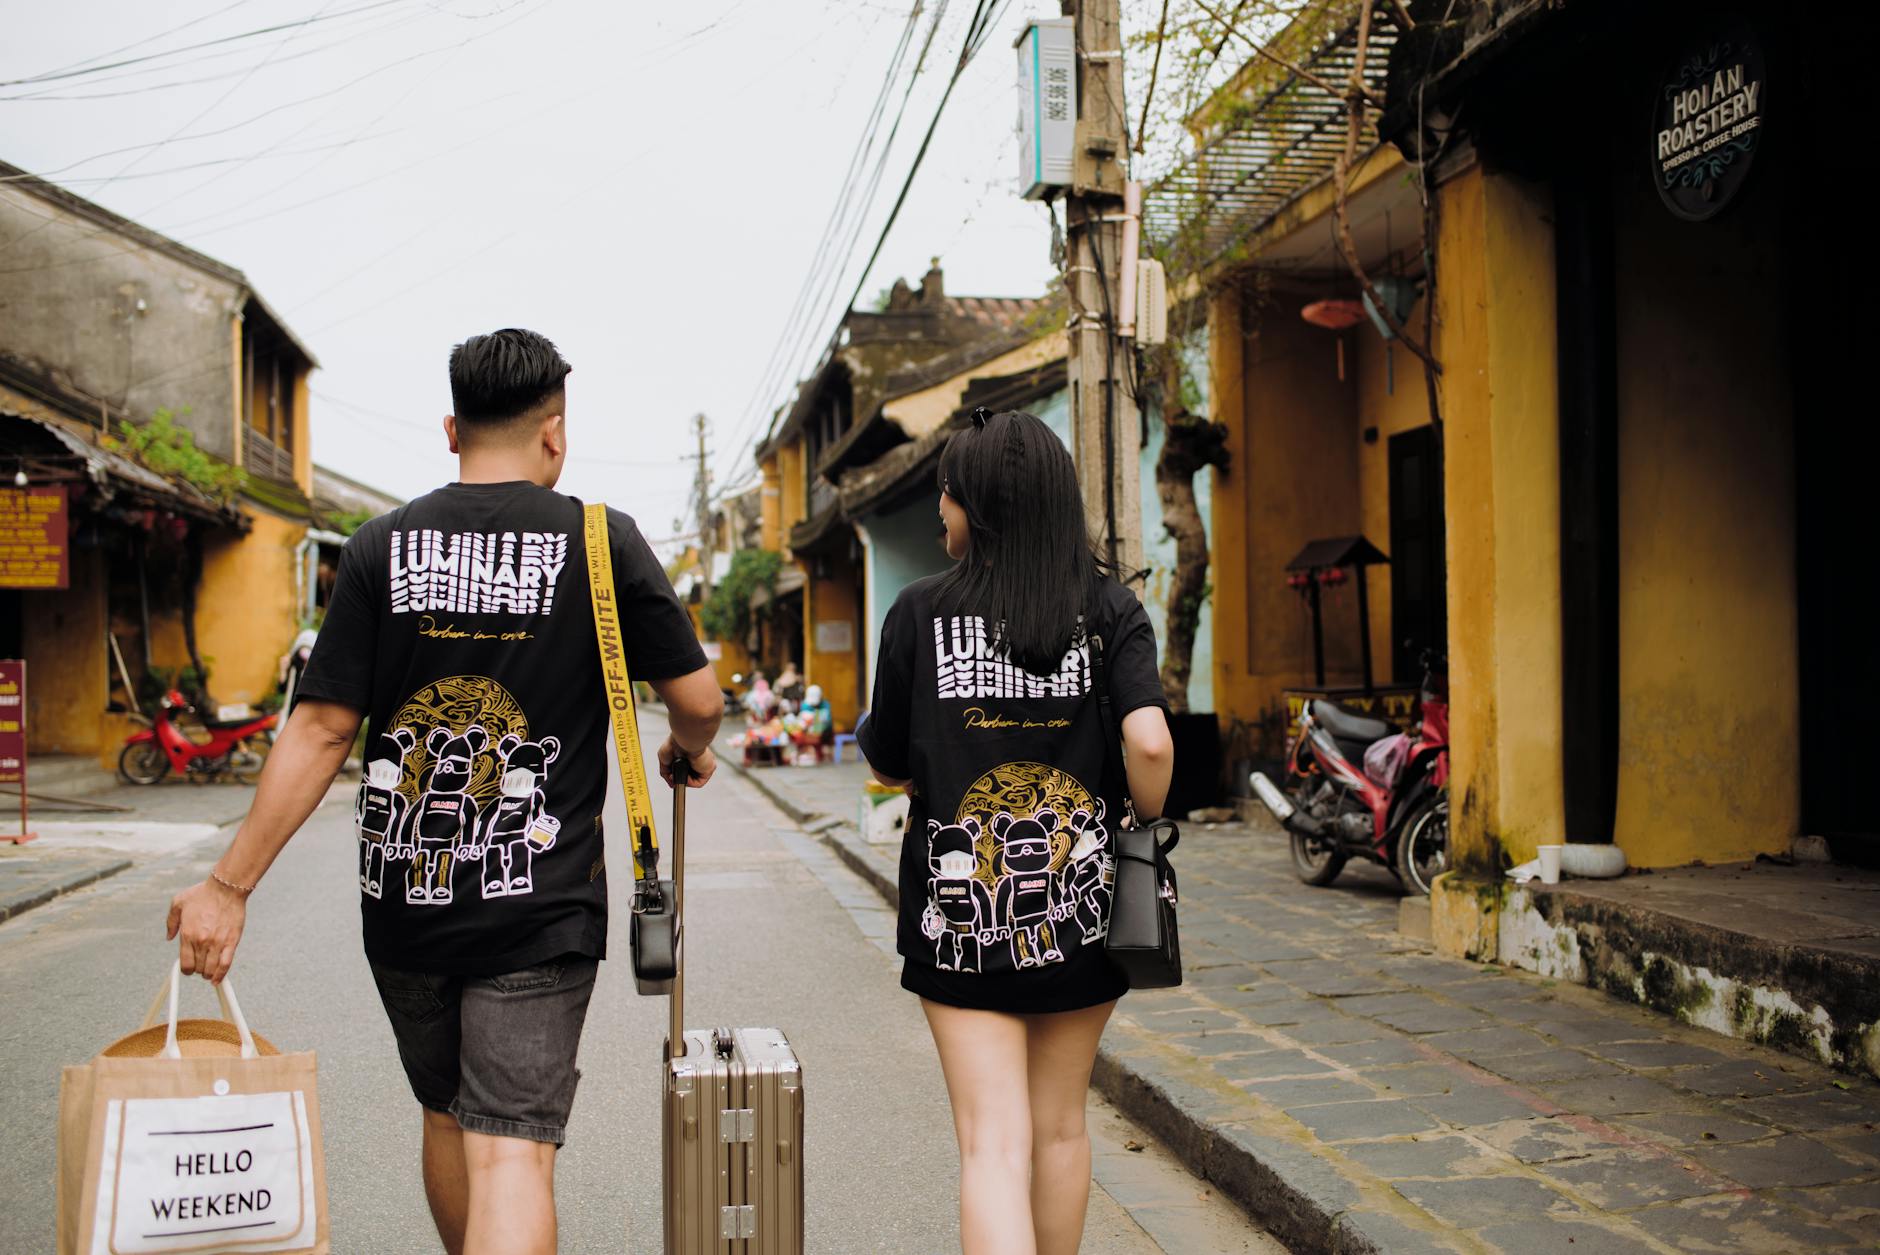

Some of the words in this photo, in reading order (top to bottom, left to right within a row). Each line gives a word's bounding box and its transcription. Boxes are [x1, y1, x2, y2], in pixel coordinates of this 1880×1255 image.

[1658, 80, 1761, 160] ROASTERY
[1674, 84, 1710, 124] HOI
[1711, 64, 1744, 103] AN
[1702, 131, 1732, 152] COFFEE
[1732, 116, 1760, 137] HOUSE
[390, 529, 568, 615] LUMINARY
[596, 588, 628, 711] OFF-WHITE
[176, 1149, 253, 1177] HELLO
[150, 1189, 272, 1221] WEEKEND
